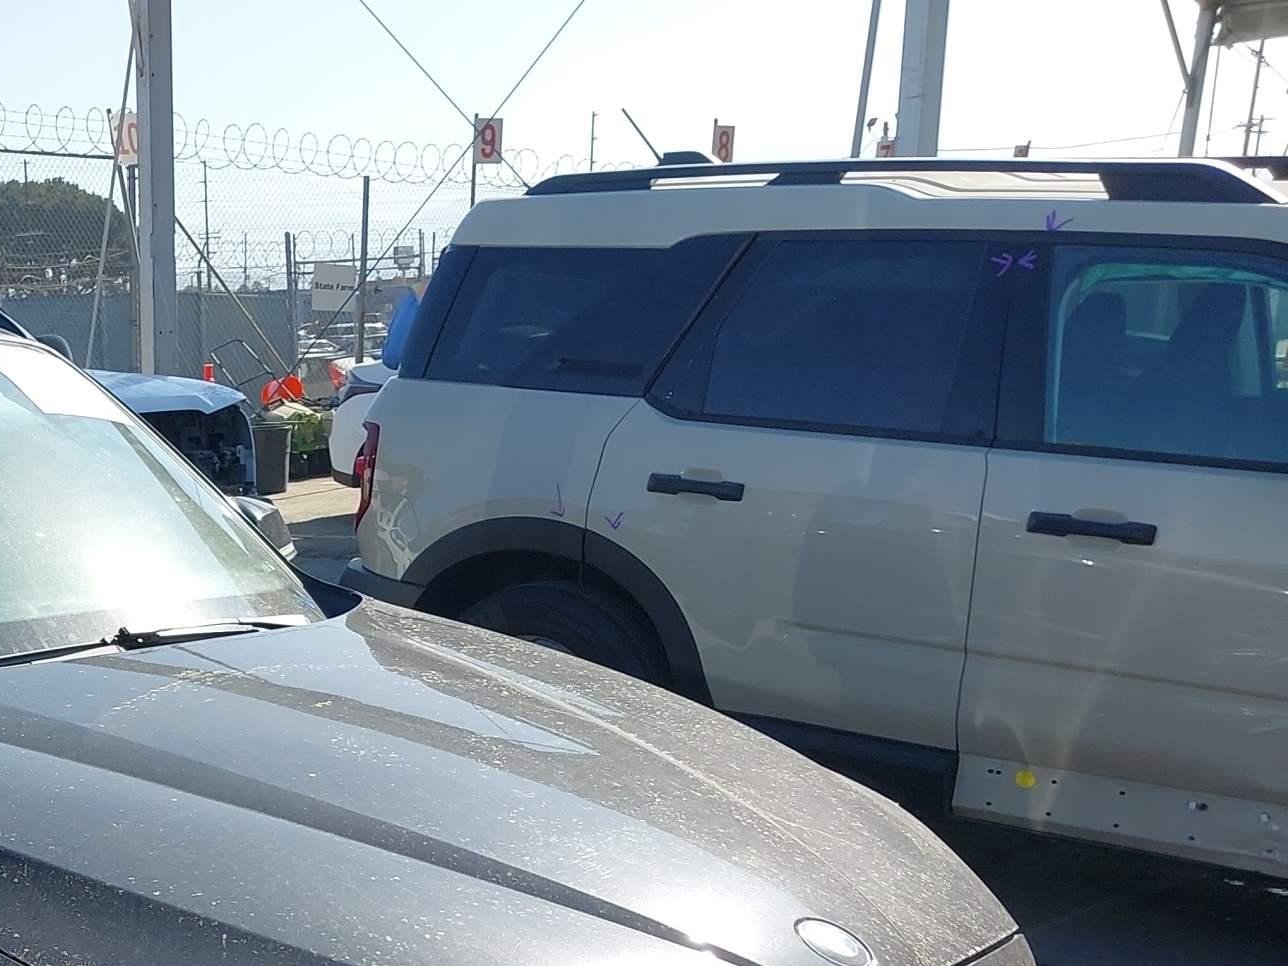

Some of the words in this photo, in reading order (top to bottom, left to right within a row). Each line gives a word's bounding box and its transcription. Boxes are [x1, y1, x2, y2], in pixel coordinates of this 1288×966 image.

[481, 123, 496, 159] 9
[718, 130, 730, 162] 8
[314, 281, 334, 291] State
[336, 282, 355, 292] Farm
